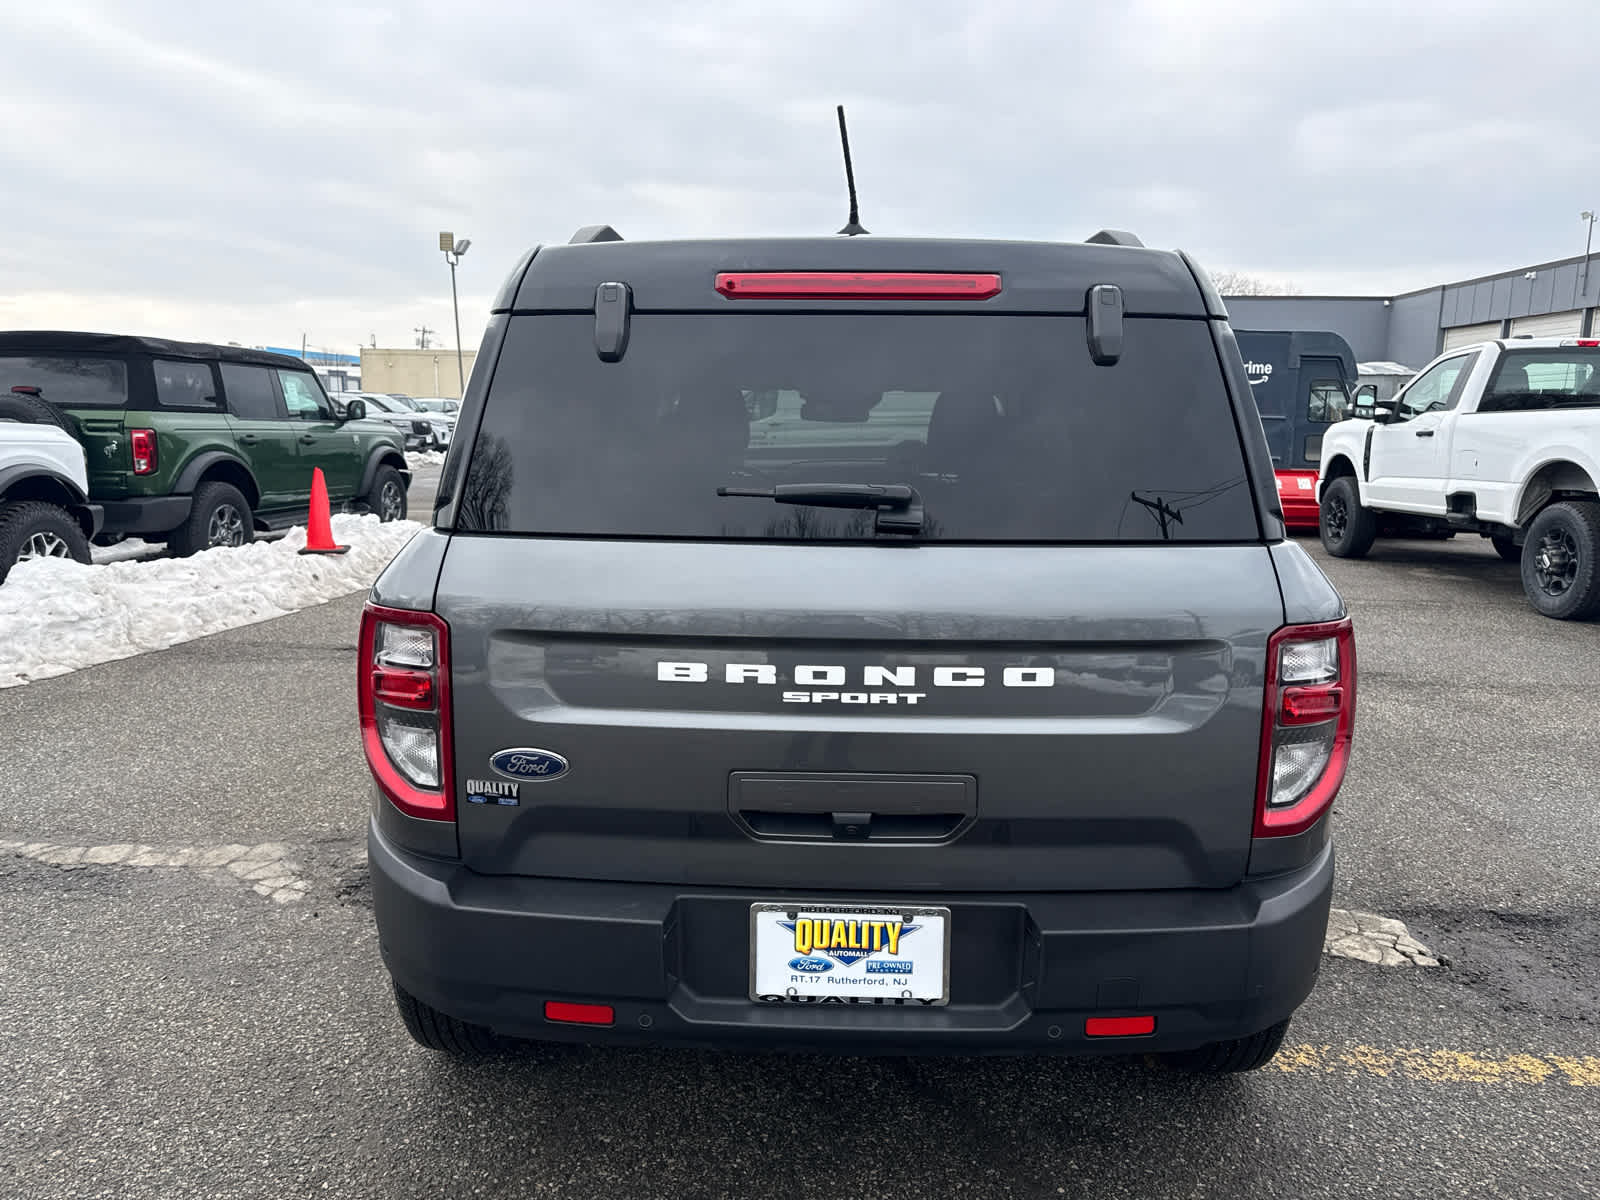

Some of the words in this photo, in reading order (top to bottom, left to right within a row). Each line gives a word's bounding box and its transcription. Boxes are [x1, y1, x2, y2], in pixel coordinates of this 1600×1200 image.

[1243, 360, 1273, 375] rime
[657, 661, 1055, 687] BRONCO
[782, 691, 926, 705] SPORT
[506, 754, 550, 774] Ford
[466, 779, 519, 797] QUALITY
[794, 918, 903, 955] QUALITY
[828, 950, 869, 958] AUTOMALL
[797, 957, 825, 971] Ford
[827, 976, 889, 986] Rutherford,
[893, 977, 908, 985] NJ
